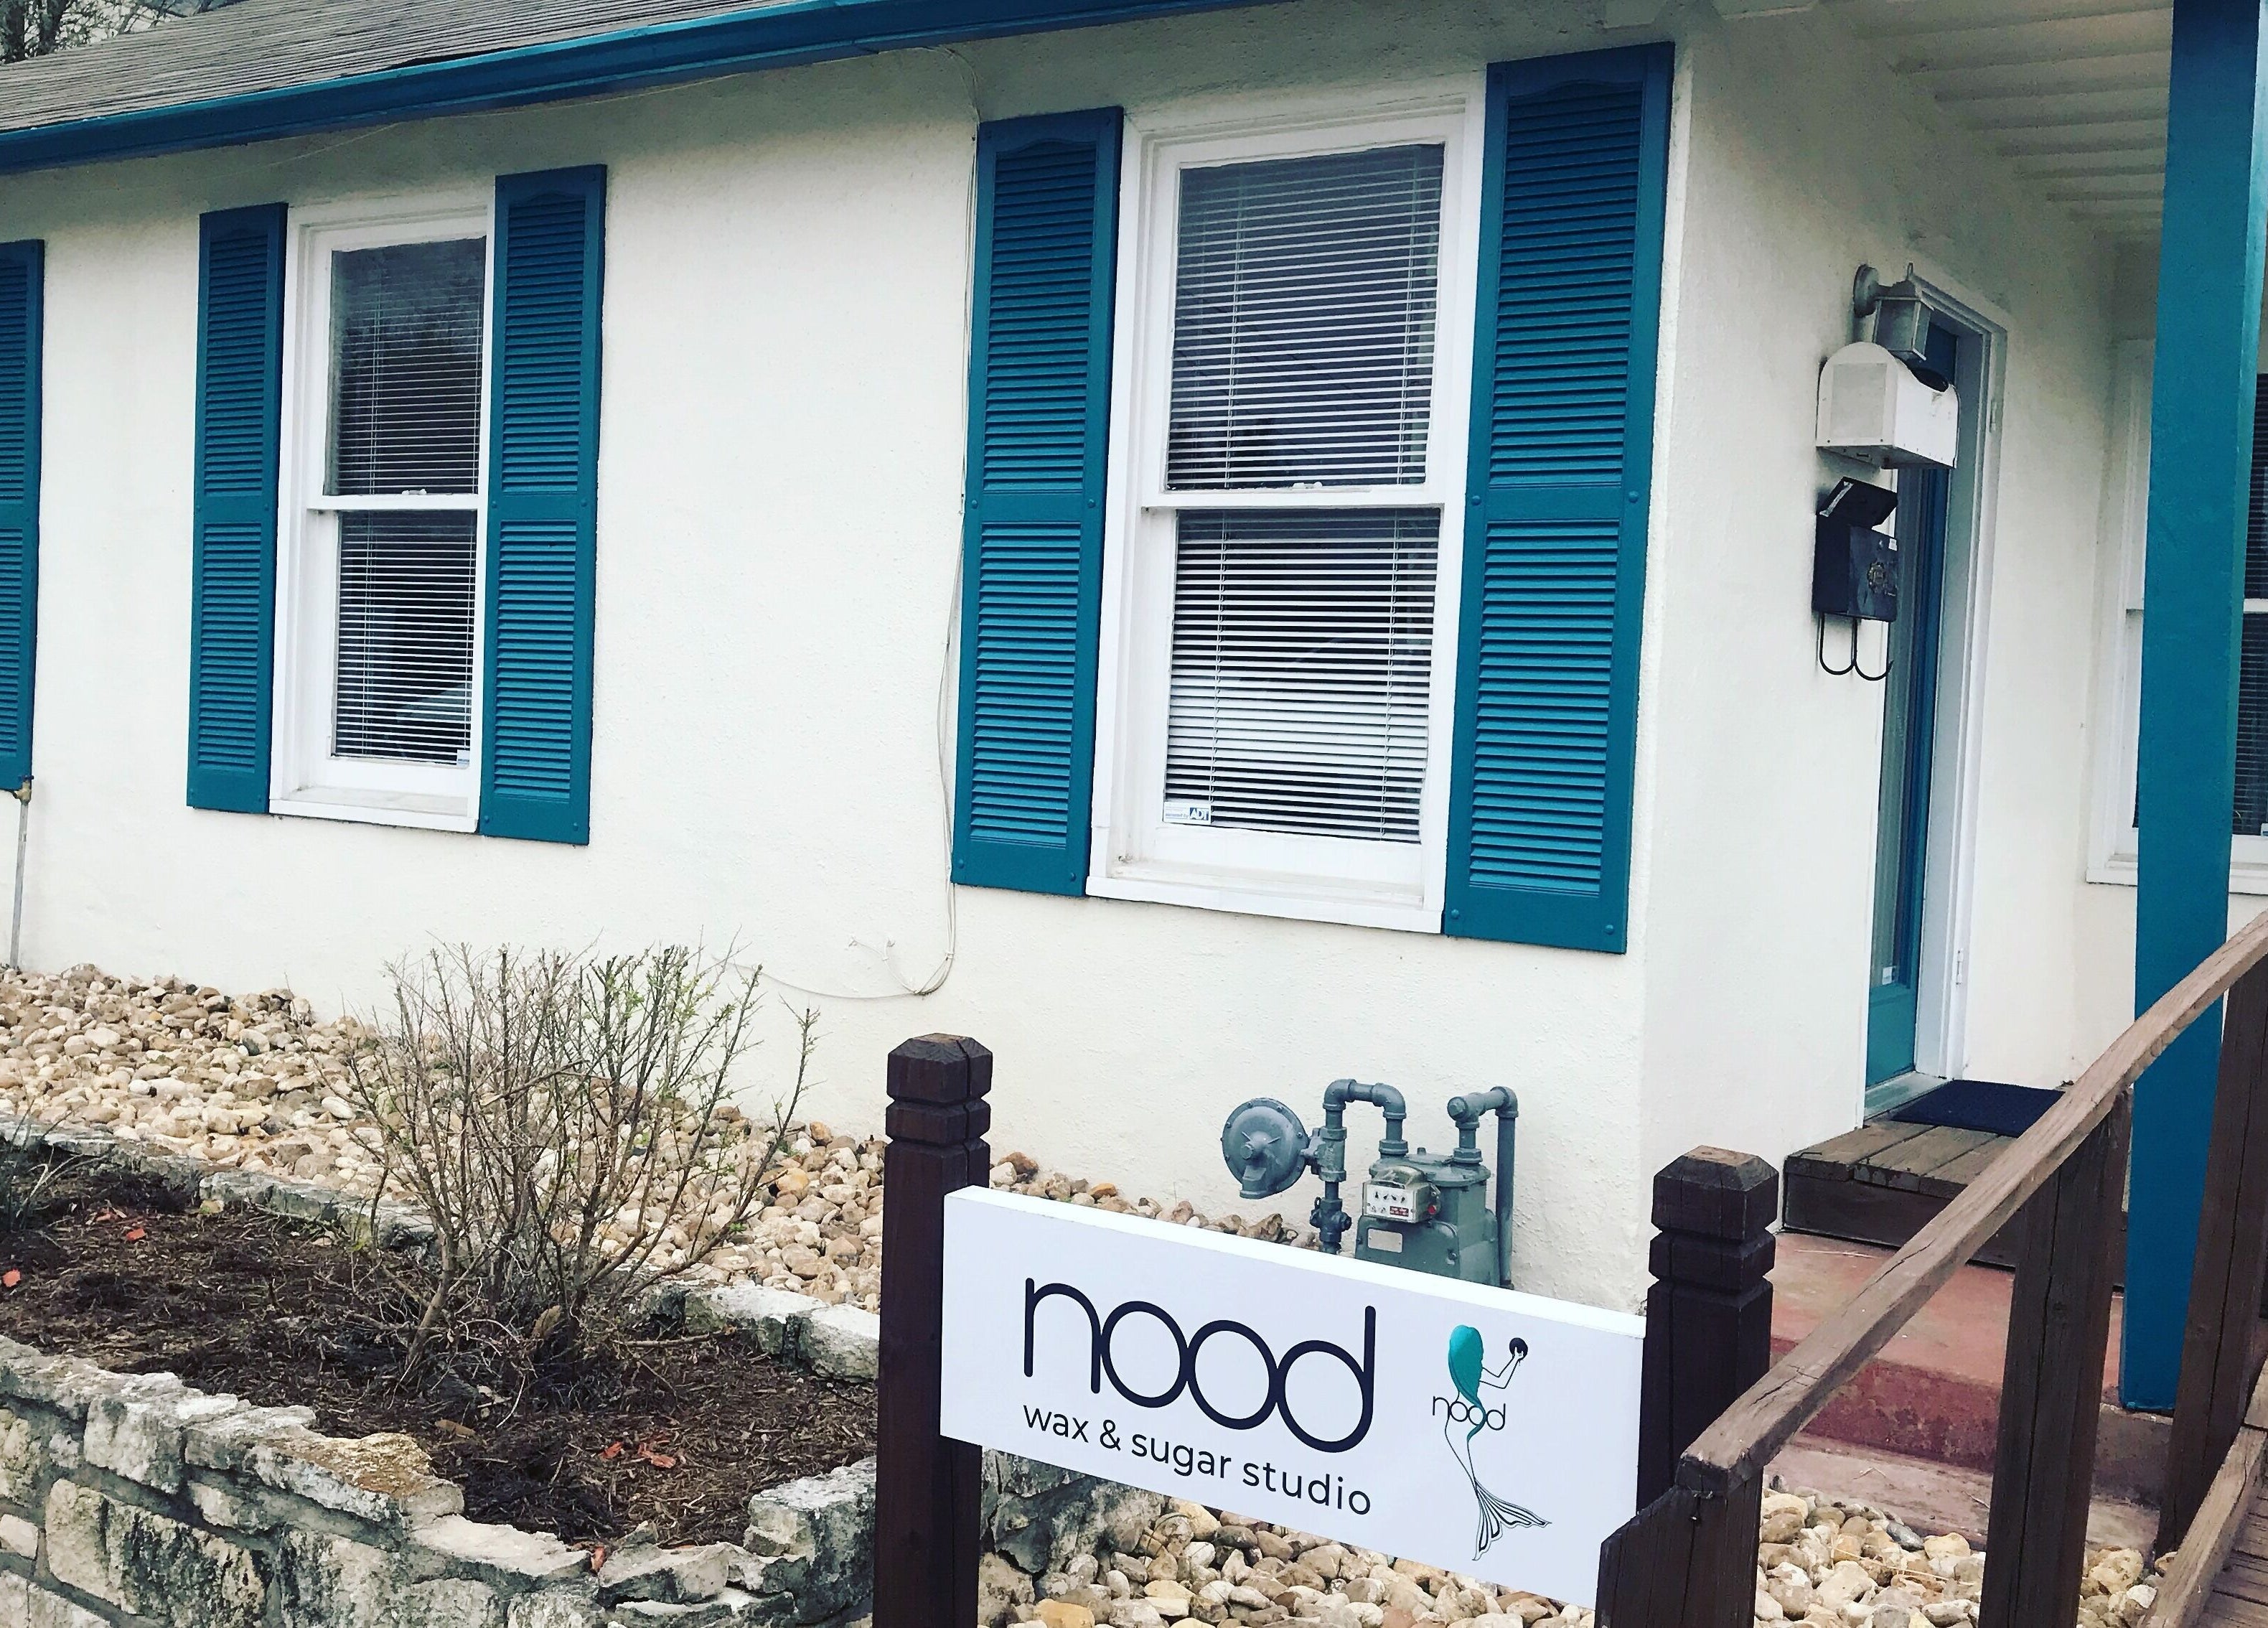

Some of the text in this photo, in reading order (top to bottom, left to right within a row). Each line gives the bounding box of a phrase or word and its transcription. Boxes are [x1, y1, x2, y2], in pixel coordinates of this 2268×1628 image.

[1190, 808, 1209, 820] ADT
[1023, 1277, 1377, 1454] nood
[1432, 1395, 1506, 1431] nood
[1023, 1405, 1371, 1515] wax & sugar studio
